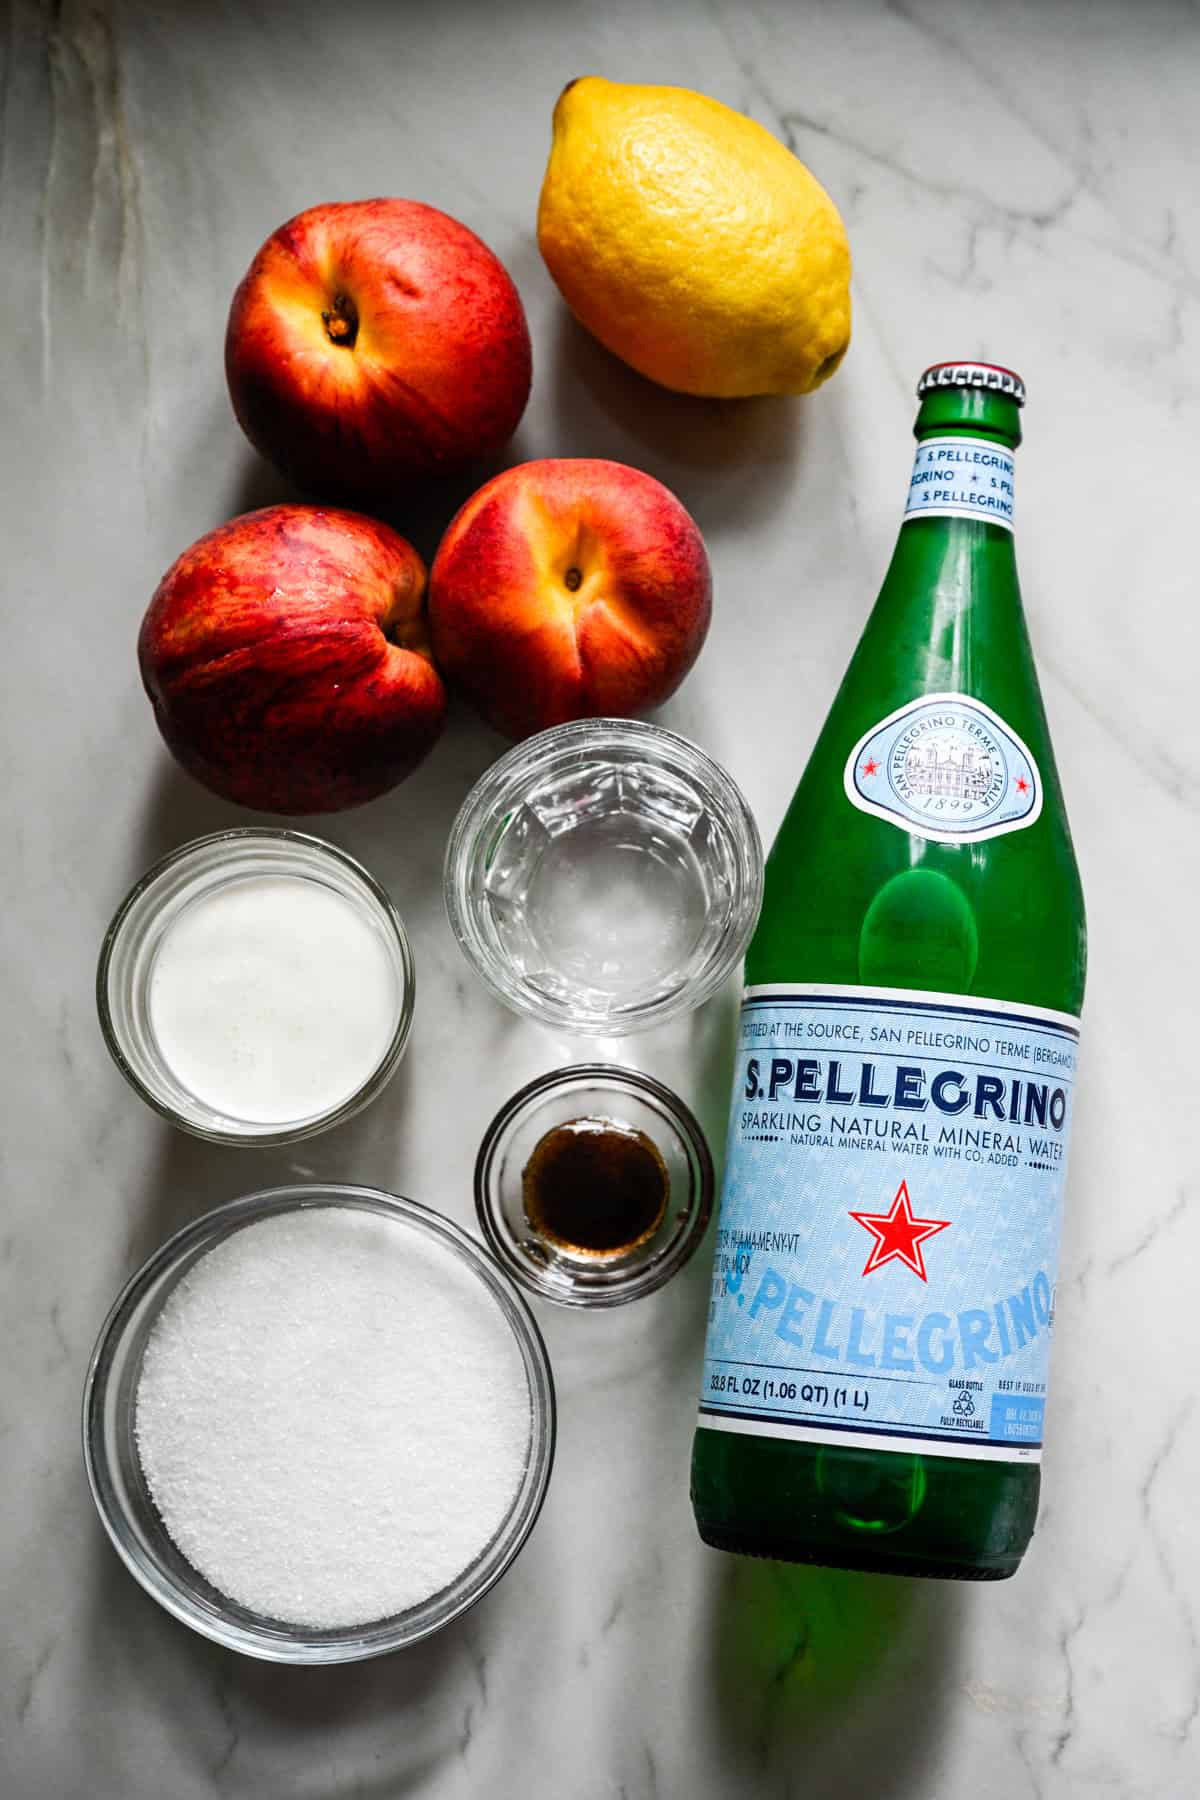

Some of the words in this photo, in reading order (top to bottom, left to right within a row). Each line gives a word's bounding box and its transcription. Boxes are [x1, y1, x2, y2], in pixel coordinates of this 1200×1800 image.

[922, 490, 1013, 516] S.PELLEGRINO
[894, 716, 955, 769] PELLEGRINO
[962, 720, 997, 754] TERME
[894, 774, 914, 799] SAN
[982, 773, 1004, 808] ITALIA
[923, 797, 973, 813] 1899
[769, 1022, 781, 1037] AT
[783, 1022, 803, 1037] THE
[807, 1023, 864, 1042] SOURCE,
[870, 1027, 901, 1042] SAN
[907, 1030, 990, 1053] PELLEGRINO
[995, 1039, 1030, 1059] TERME
[745, 1058, 1067, 1133] S.PELLEGRINO
[741, 1112, 821, 1132] SPARKLING
[830, 1117, 929, 1142] NATURAL
[939, 1127, 1023, 1153] MINERAL
[790, 1134, 834, 1147] NATURAL
[838, 1137, 887, 1152] MINERAL
[892, 1142, 929, 1156] WATER
[933, 1145, 961, 1159] WITH
[987, 1152, 1019, 1167] ADDED
[711, 1375, 726, 1391] 33.8
[727, 1376, 739, 1393] FL
[742, 1379, 760, 1396] OZ
[763, 1381, 797, 1400] (1.06
[801, 1386, 829, 1407] QT)
[834, 1389, 848, 1407] (1
[854, 1391, 869, 1410] L)
